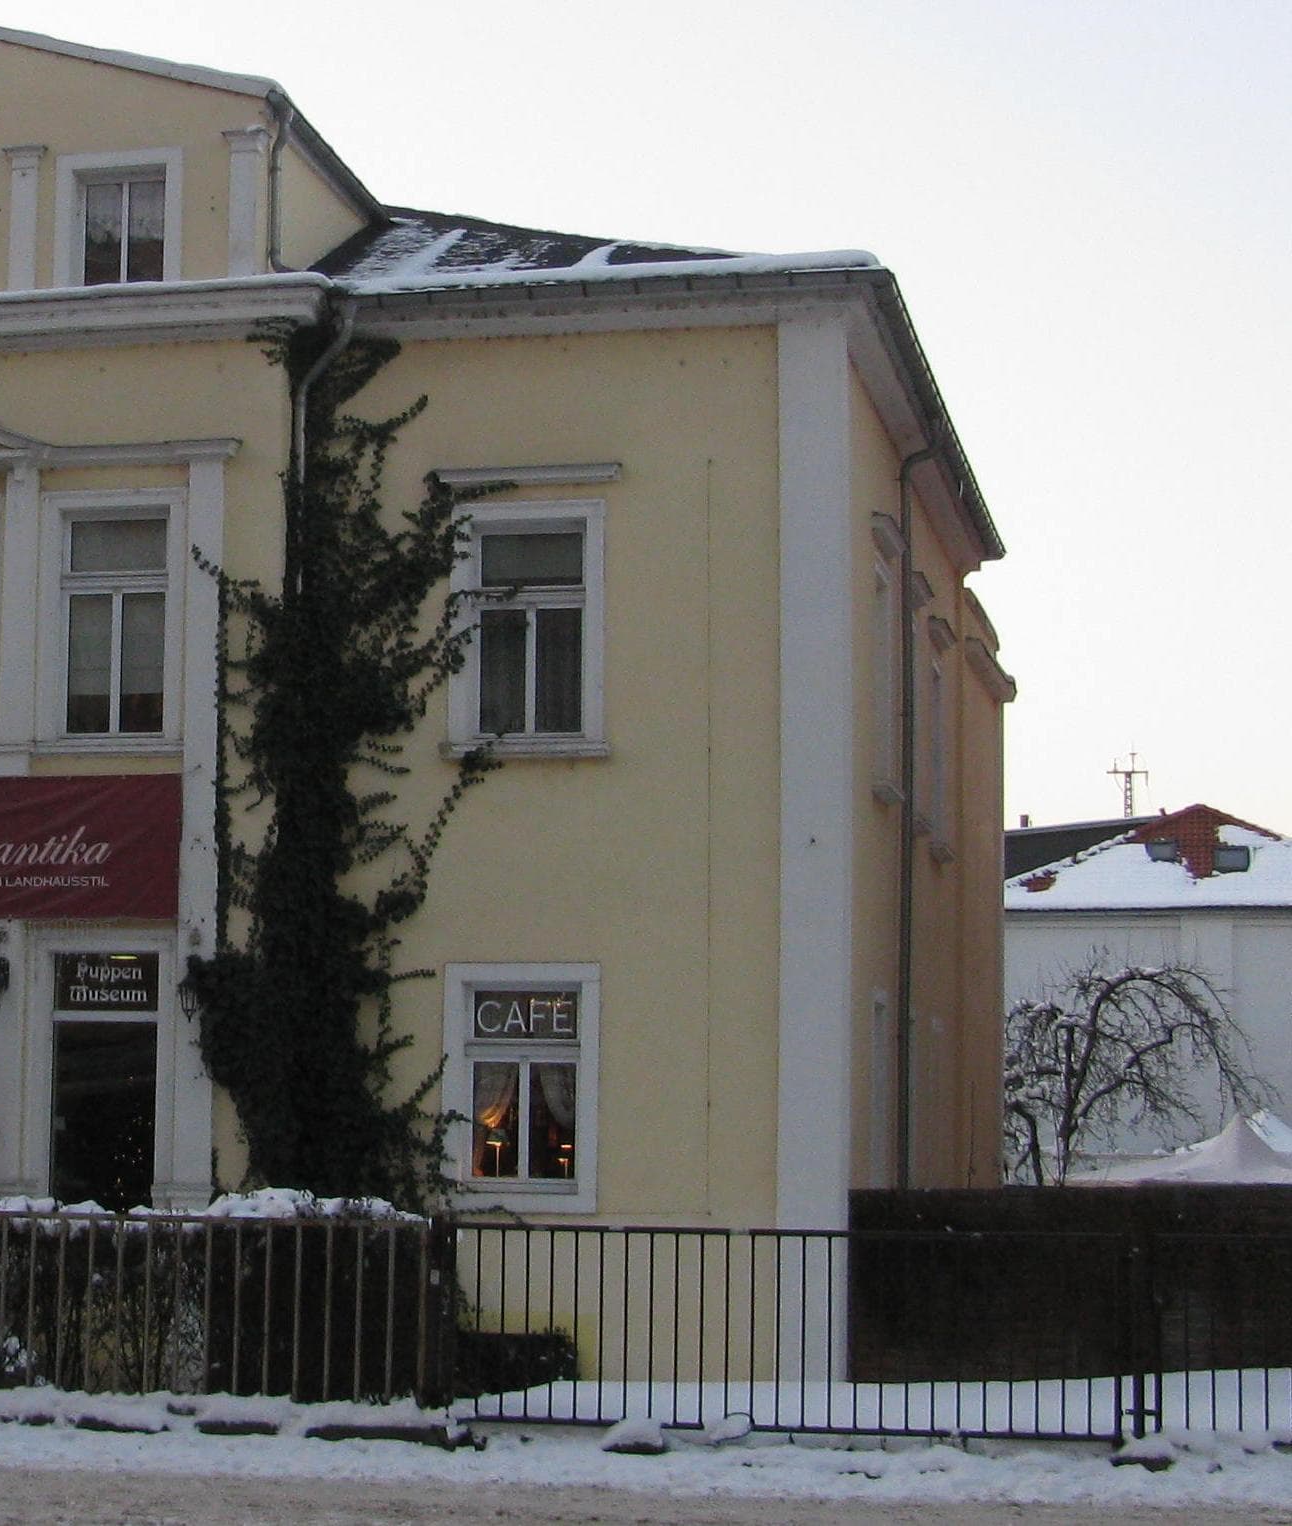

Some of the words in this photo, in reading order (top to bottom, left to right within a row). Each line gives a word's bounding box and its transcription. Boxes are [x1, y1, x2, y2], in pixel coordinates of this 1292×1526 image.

[5, 875, 109, 888] LANDHAUSSTIL
[75, 961, 143, 983] Puppen
[68, 985, 148, 1002] Museum
